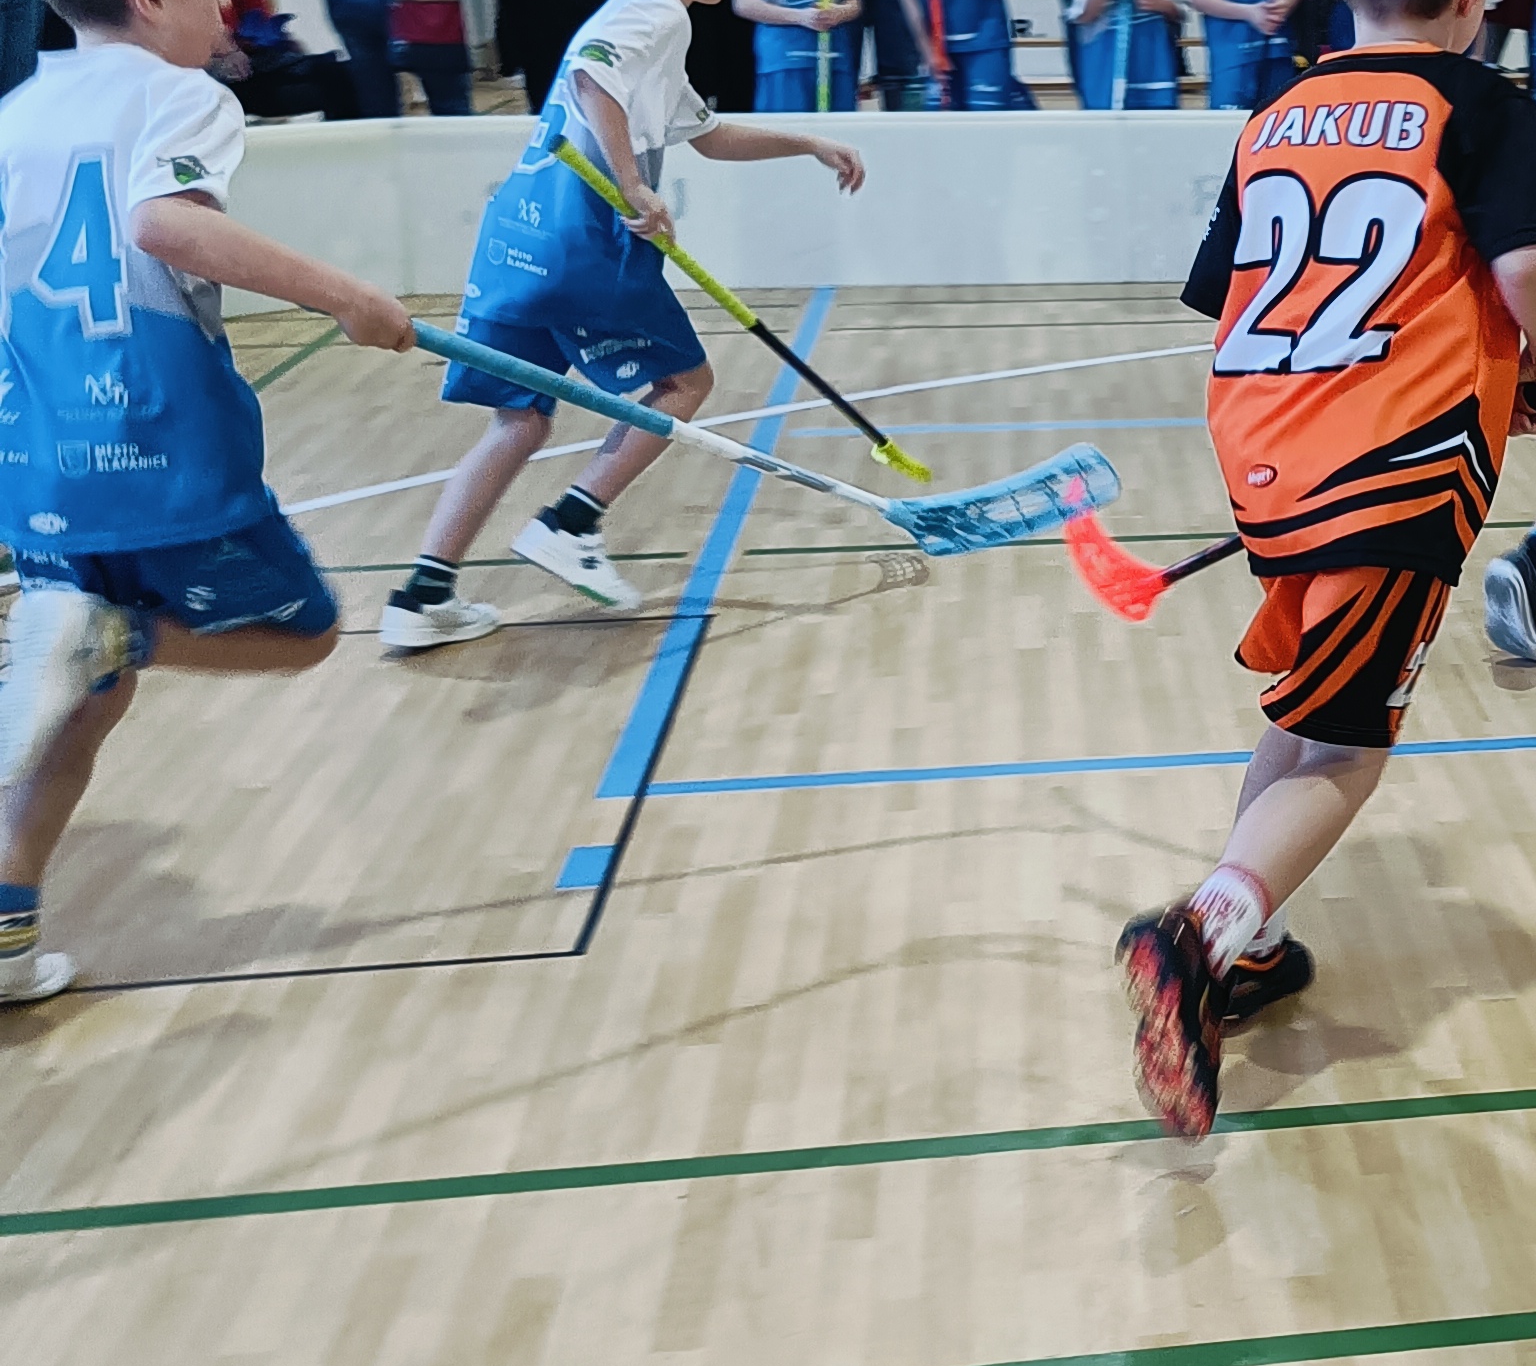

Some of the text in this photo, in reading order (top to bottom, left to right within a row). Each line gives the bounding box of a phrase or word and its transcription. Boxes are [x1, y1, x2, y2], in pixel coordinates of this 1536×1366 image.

[1250, 101, 1428, 154] JAKUB
[0, 143, 132, 339] 4
[1213, 169, 1429, 377] 22
